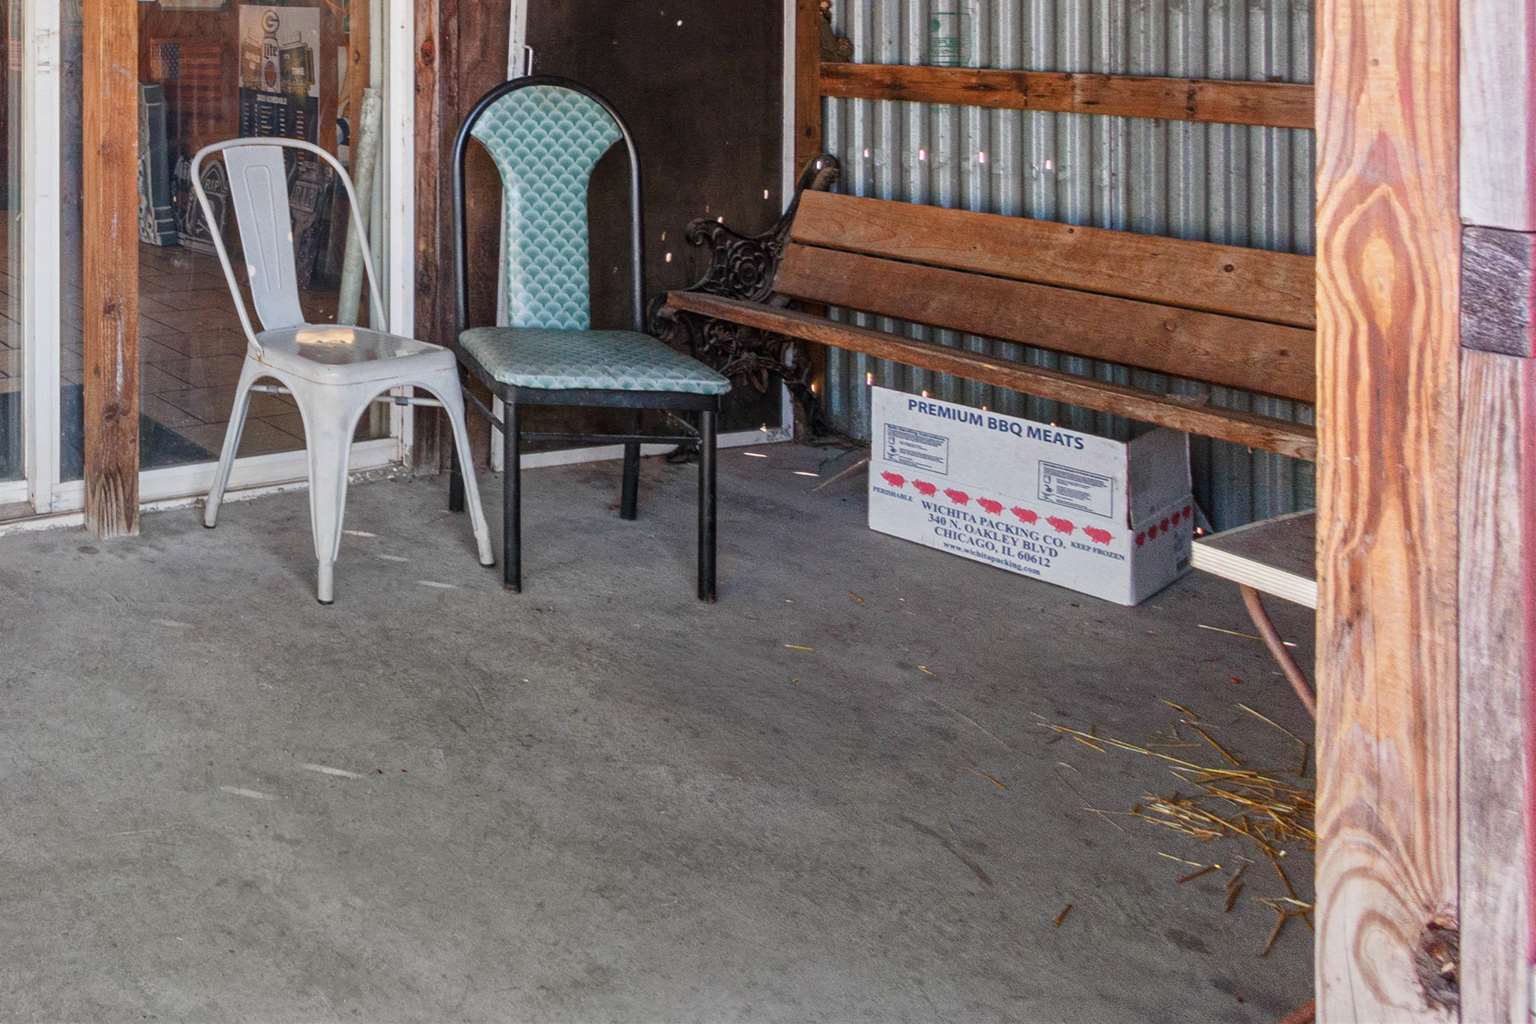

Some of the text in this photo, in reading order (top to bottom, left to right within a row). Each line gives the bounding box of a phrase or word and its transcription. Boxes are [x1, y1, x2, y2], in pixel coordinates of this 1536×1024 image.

[908, 399, 1084, 450] PREMIUM BBQ MEATS
[872, 486, 913, 502] PERISHABLE
[921, 500, 1067, 549] WICHITA PACKING CO.
[928, 513, 1059, 558] 340 N. OAKLEY BLVD
[943, 541, 1041, 576] www.wichitapacking.com
[1002, 545, 1014, 557] IL
[1017, 551, 1051, 568] 60612
[1070, 541, 1125, 561] KEEP FROZEN
